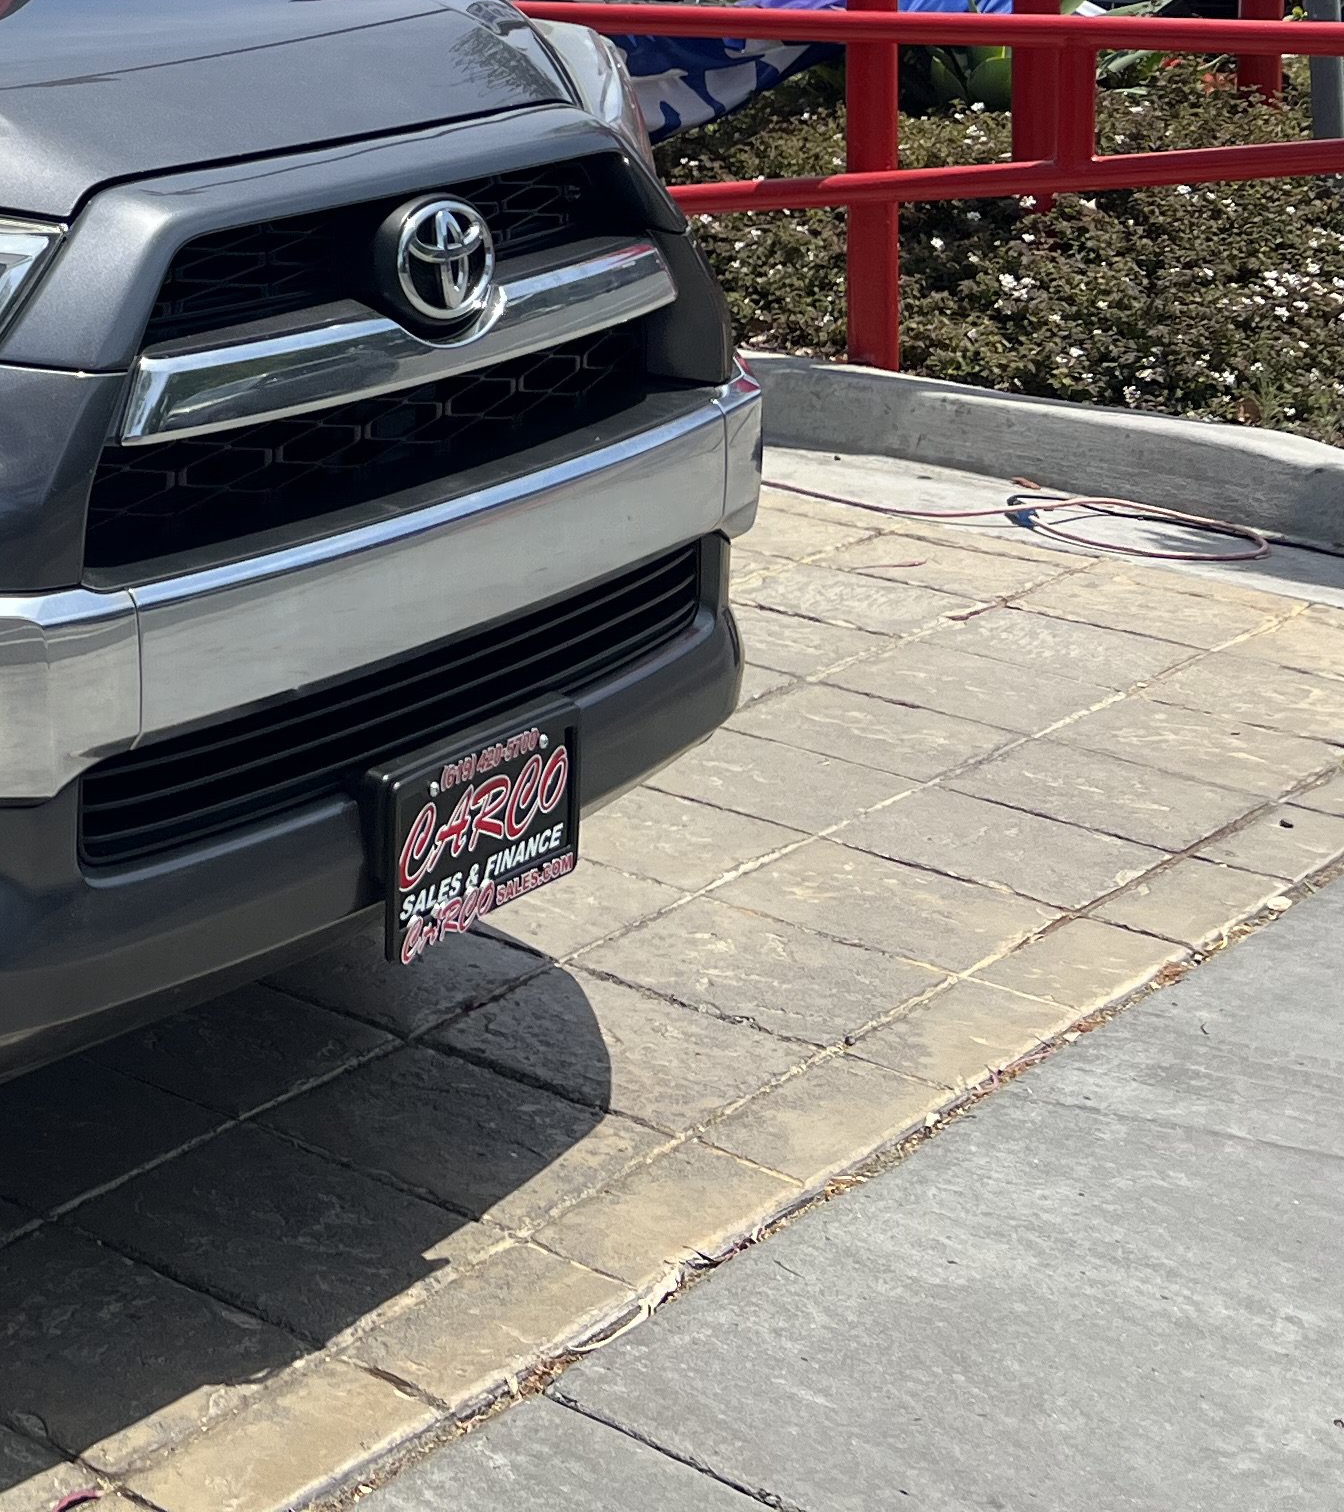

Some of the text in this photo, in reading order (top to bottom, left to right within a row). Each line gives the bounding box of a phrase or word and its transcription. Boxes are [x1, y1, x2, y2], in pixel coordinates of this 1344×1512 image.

[440, 728, 541, 792] (619) 420-5700
[399, 745, 569, 892] CARCO
[400, 823, 564, 920] SALES & FINANCE
